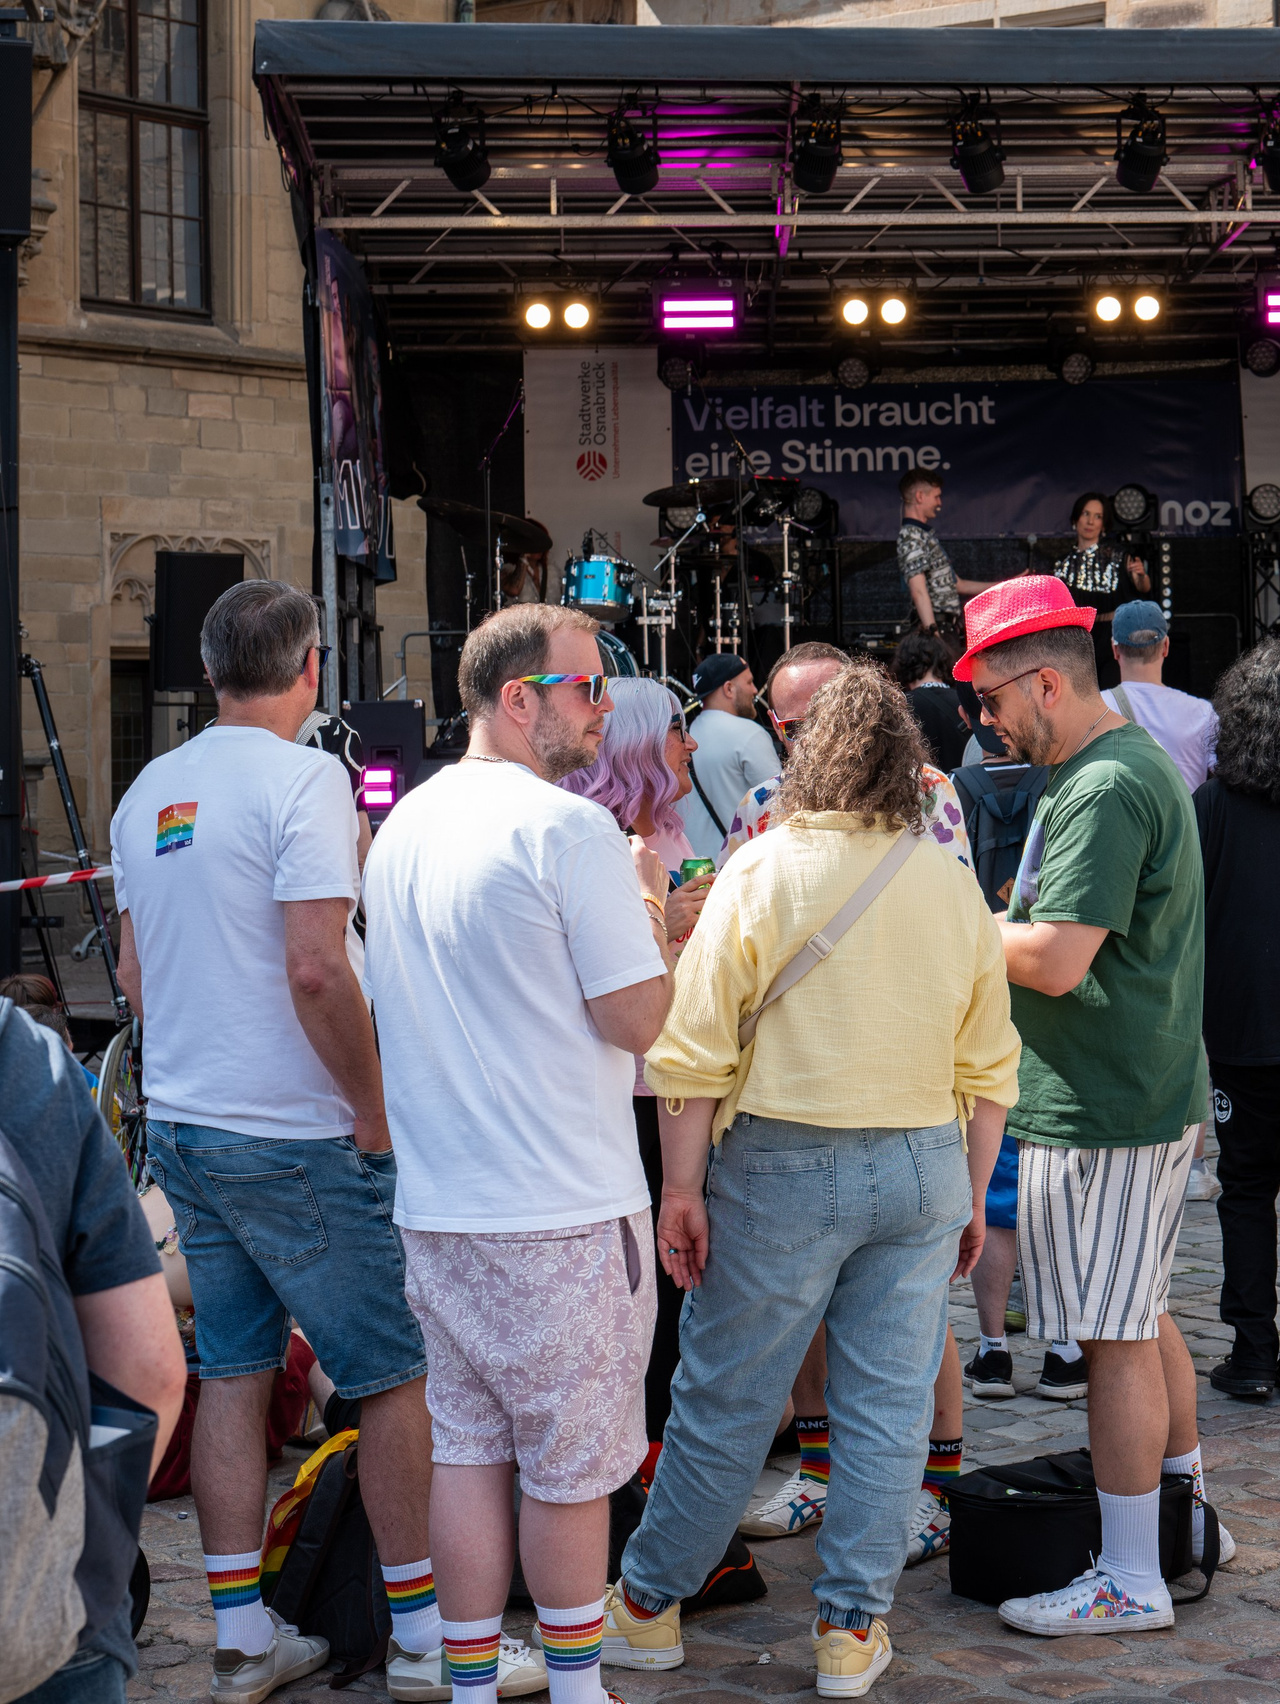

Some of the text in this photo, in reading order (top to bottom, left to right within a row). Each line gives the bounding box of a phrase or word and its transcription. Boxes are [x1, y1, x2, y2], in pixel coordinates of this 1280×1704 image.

[578, 361, 591, 445] Stadtwerke
[593, 362, 606, 446] Osnabrück
[684, 393, 996, 432] Vielfalt braucht
[685, 438, 951, 478] eine Stimme.
[1161, 500, 1232, 527] noz
